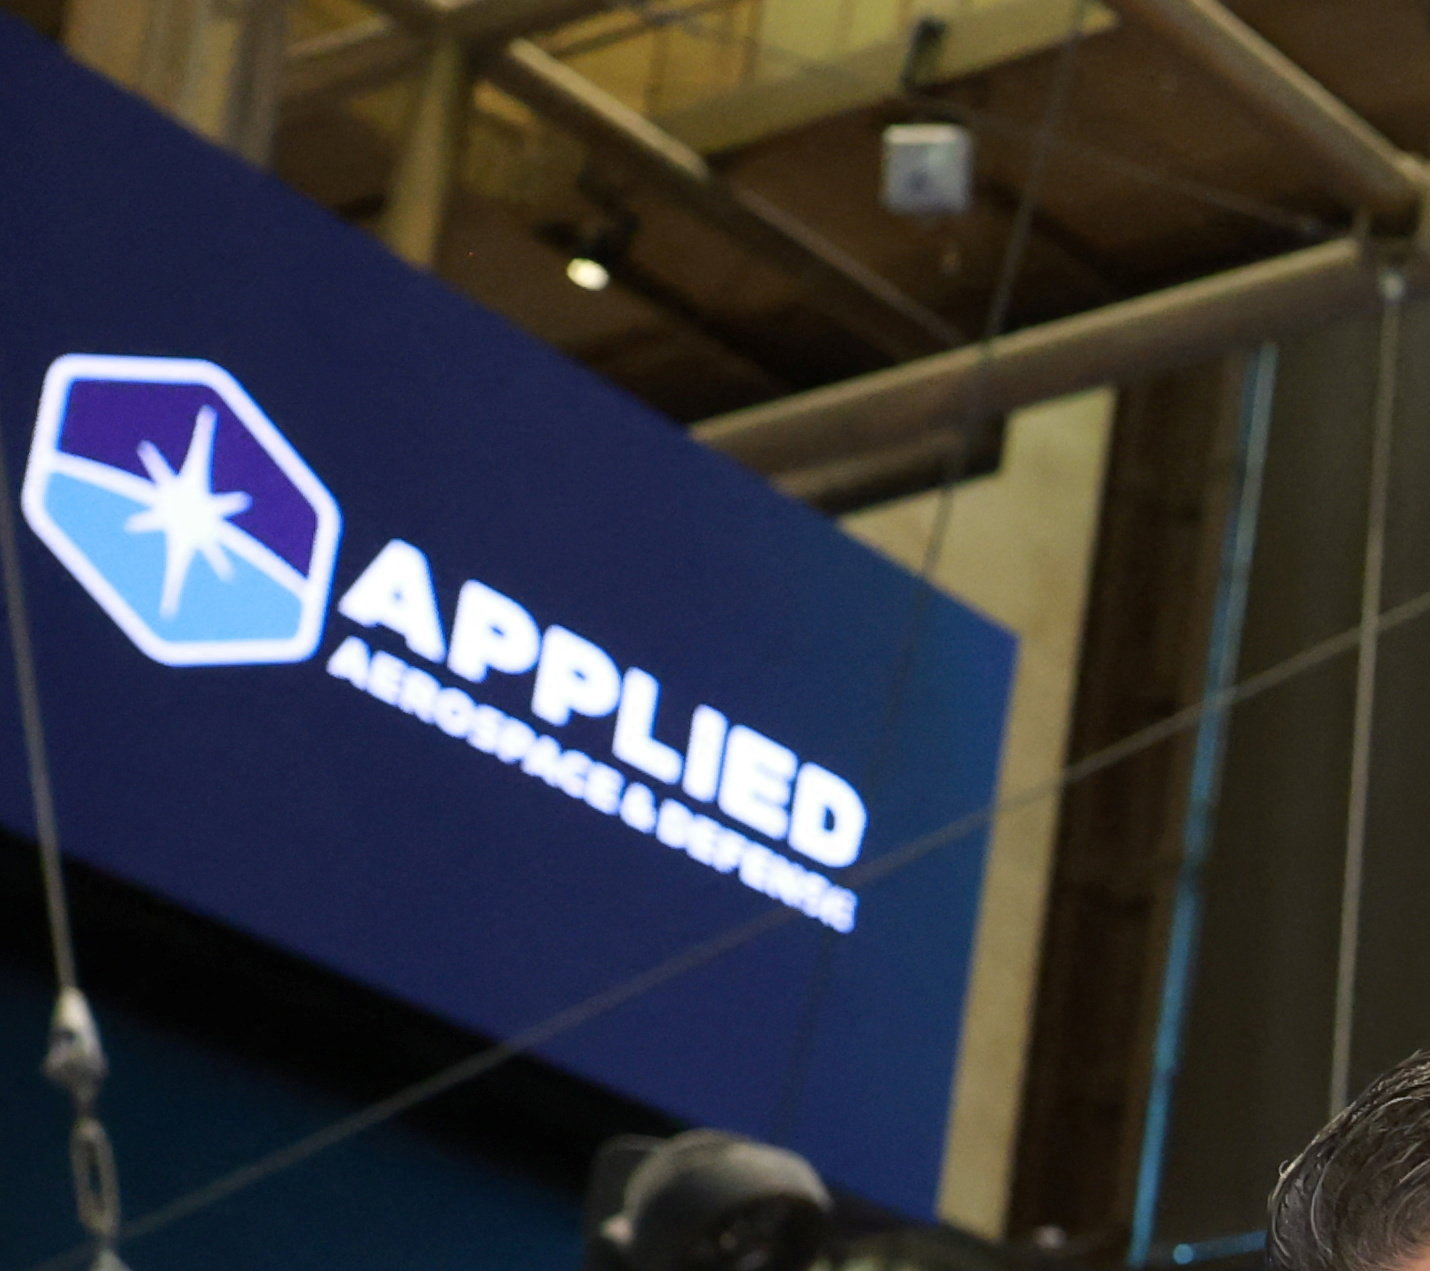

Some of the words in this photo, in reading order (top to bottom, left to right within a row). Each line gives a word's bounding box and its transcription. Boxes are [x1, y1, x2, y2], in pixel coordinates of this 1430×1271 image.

[327, 635, 625, 815] AEROSPACE
[620, 782, 657, 834] &
[655, 798, 858, 934] DEFENSE
[337, 537, 867, 869] APPLIED
